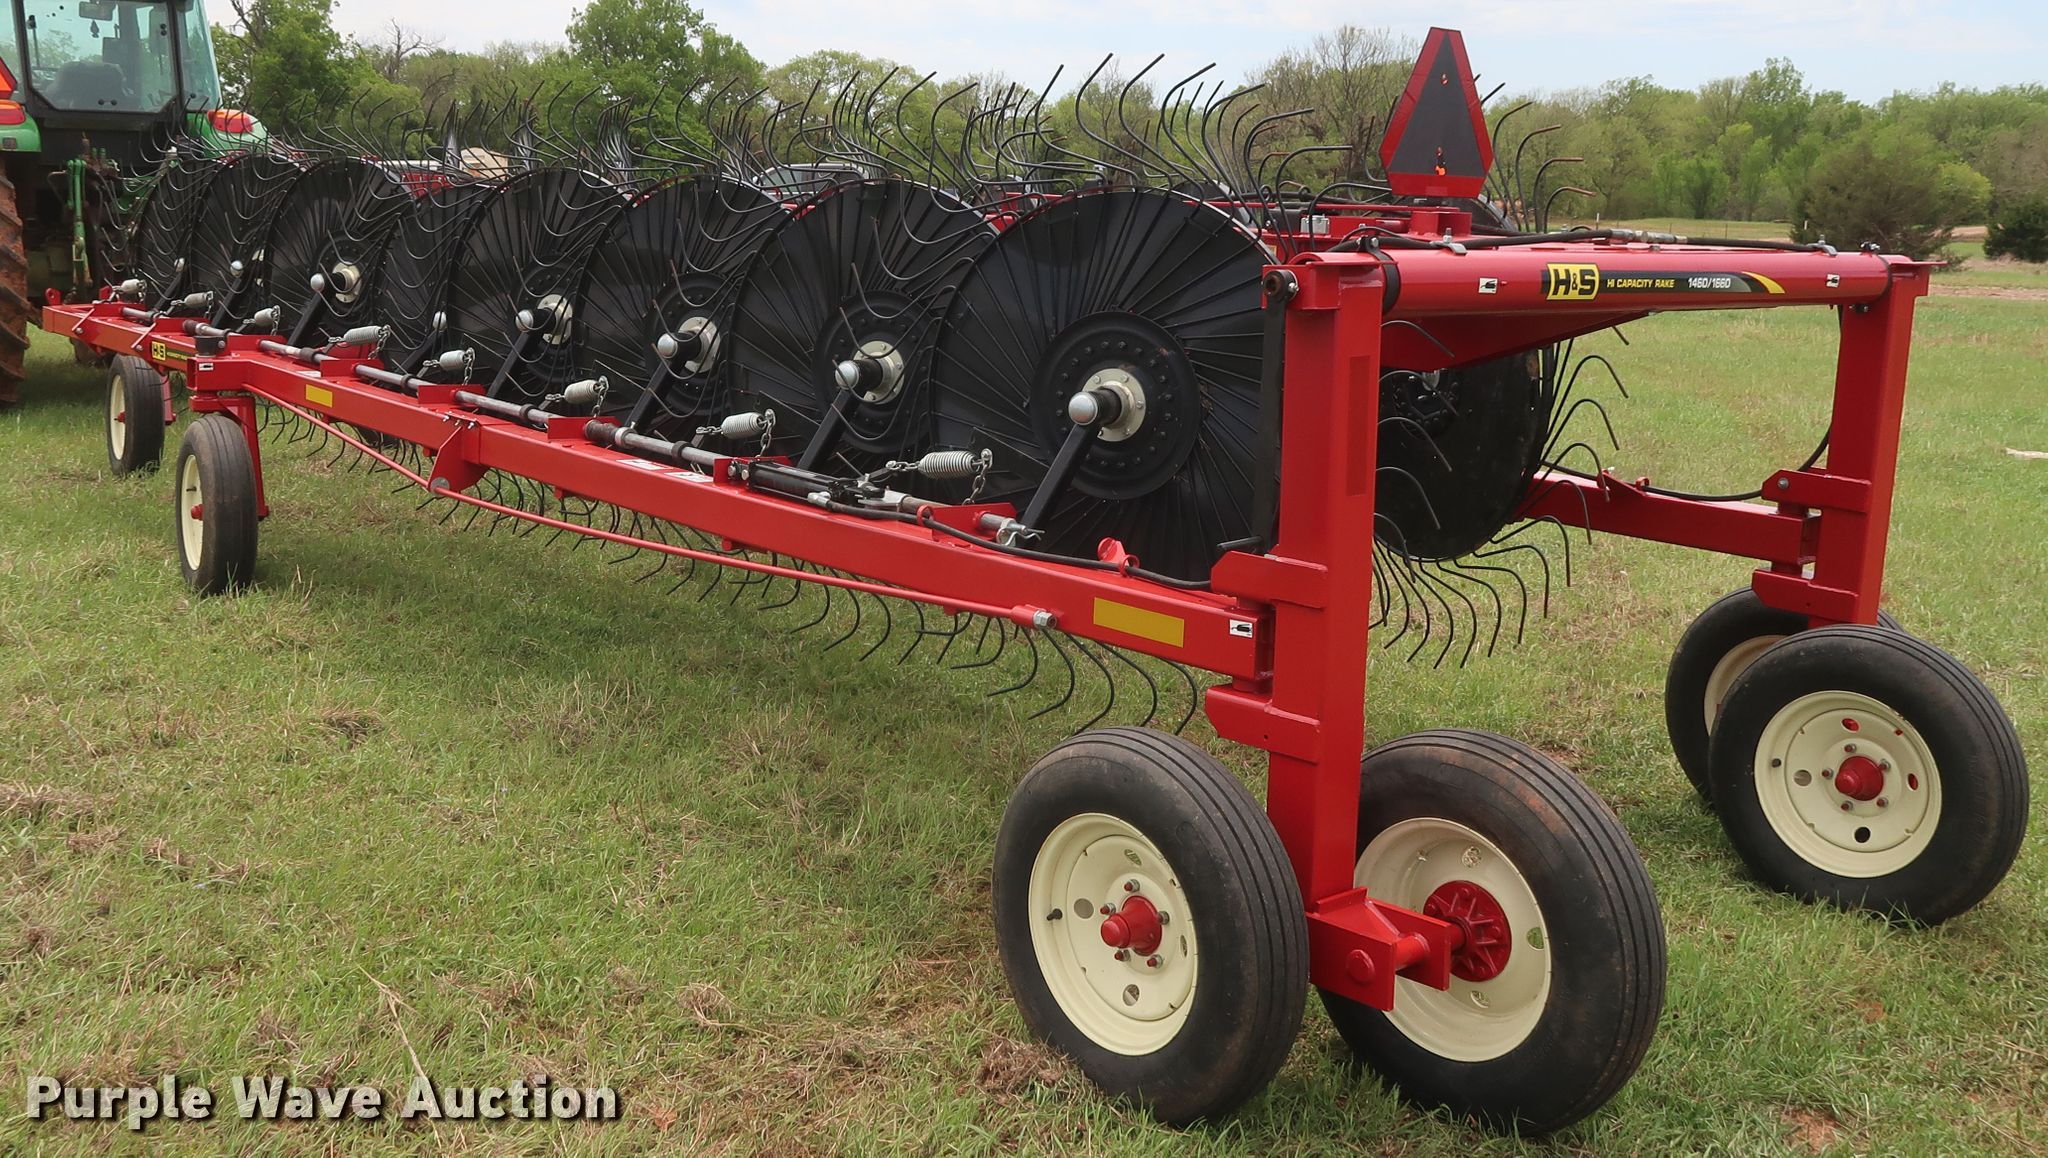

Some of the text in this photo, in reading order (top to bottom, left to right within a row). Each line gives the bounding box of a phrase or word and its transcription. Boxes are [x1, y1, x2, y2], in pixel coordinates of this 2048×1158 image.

[1552, 268, 1596, 296] H&S
[1606, 279, 1675, 288] HI CAPACITY RAKE
[1687, 277, 1731, 289] 1460/1660
[152, 342, 164, 359] HS
